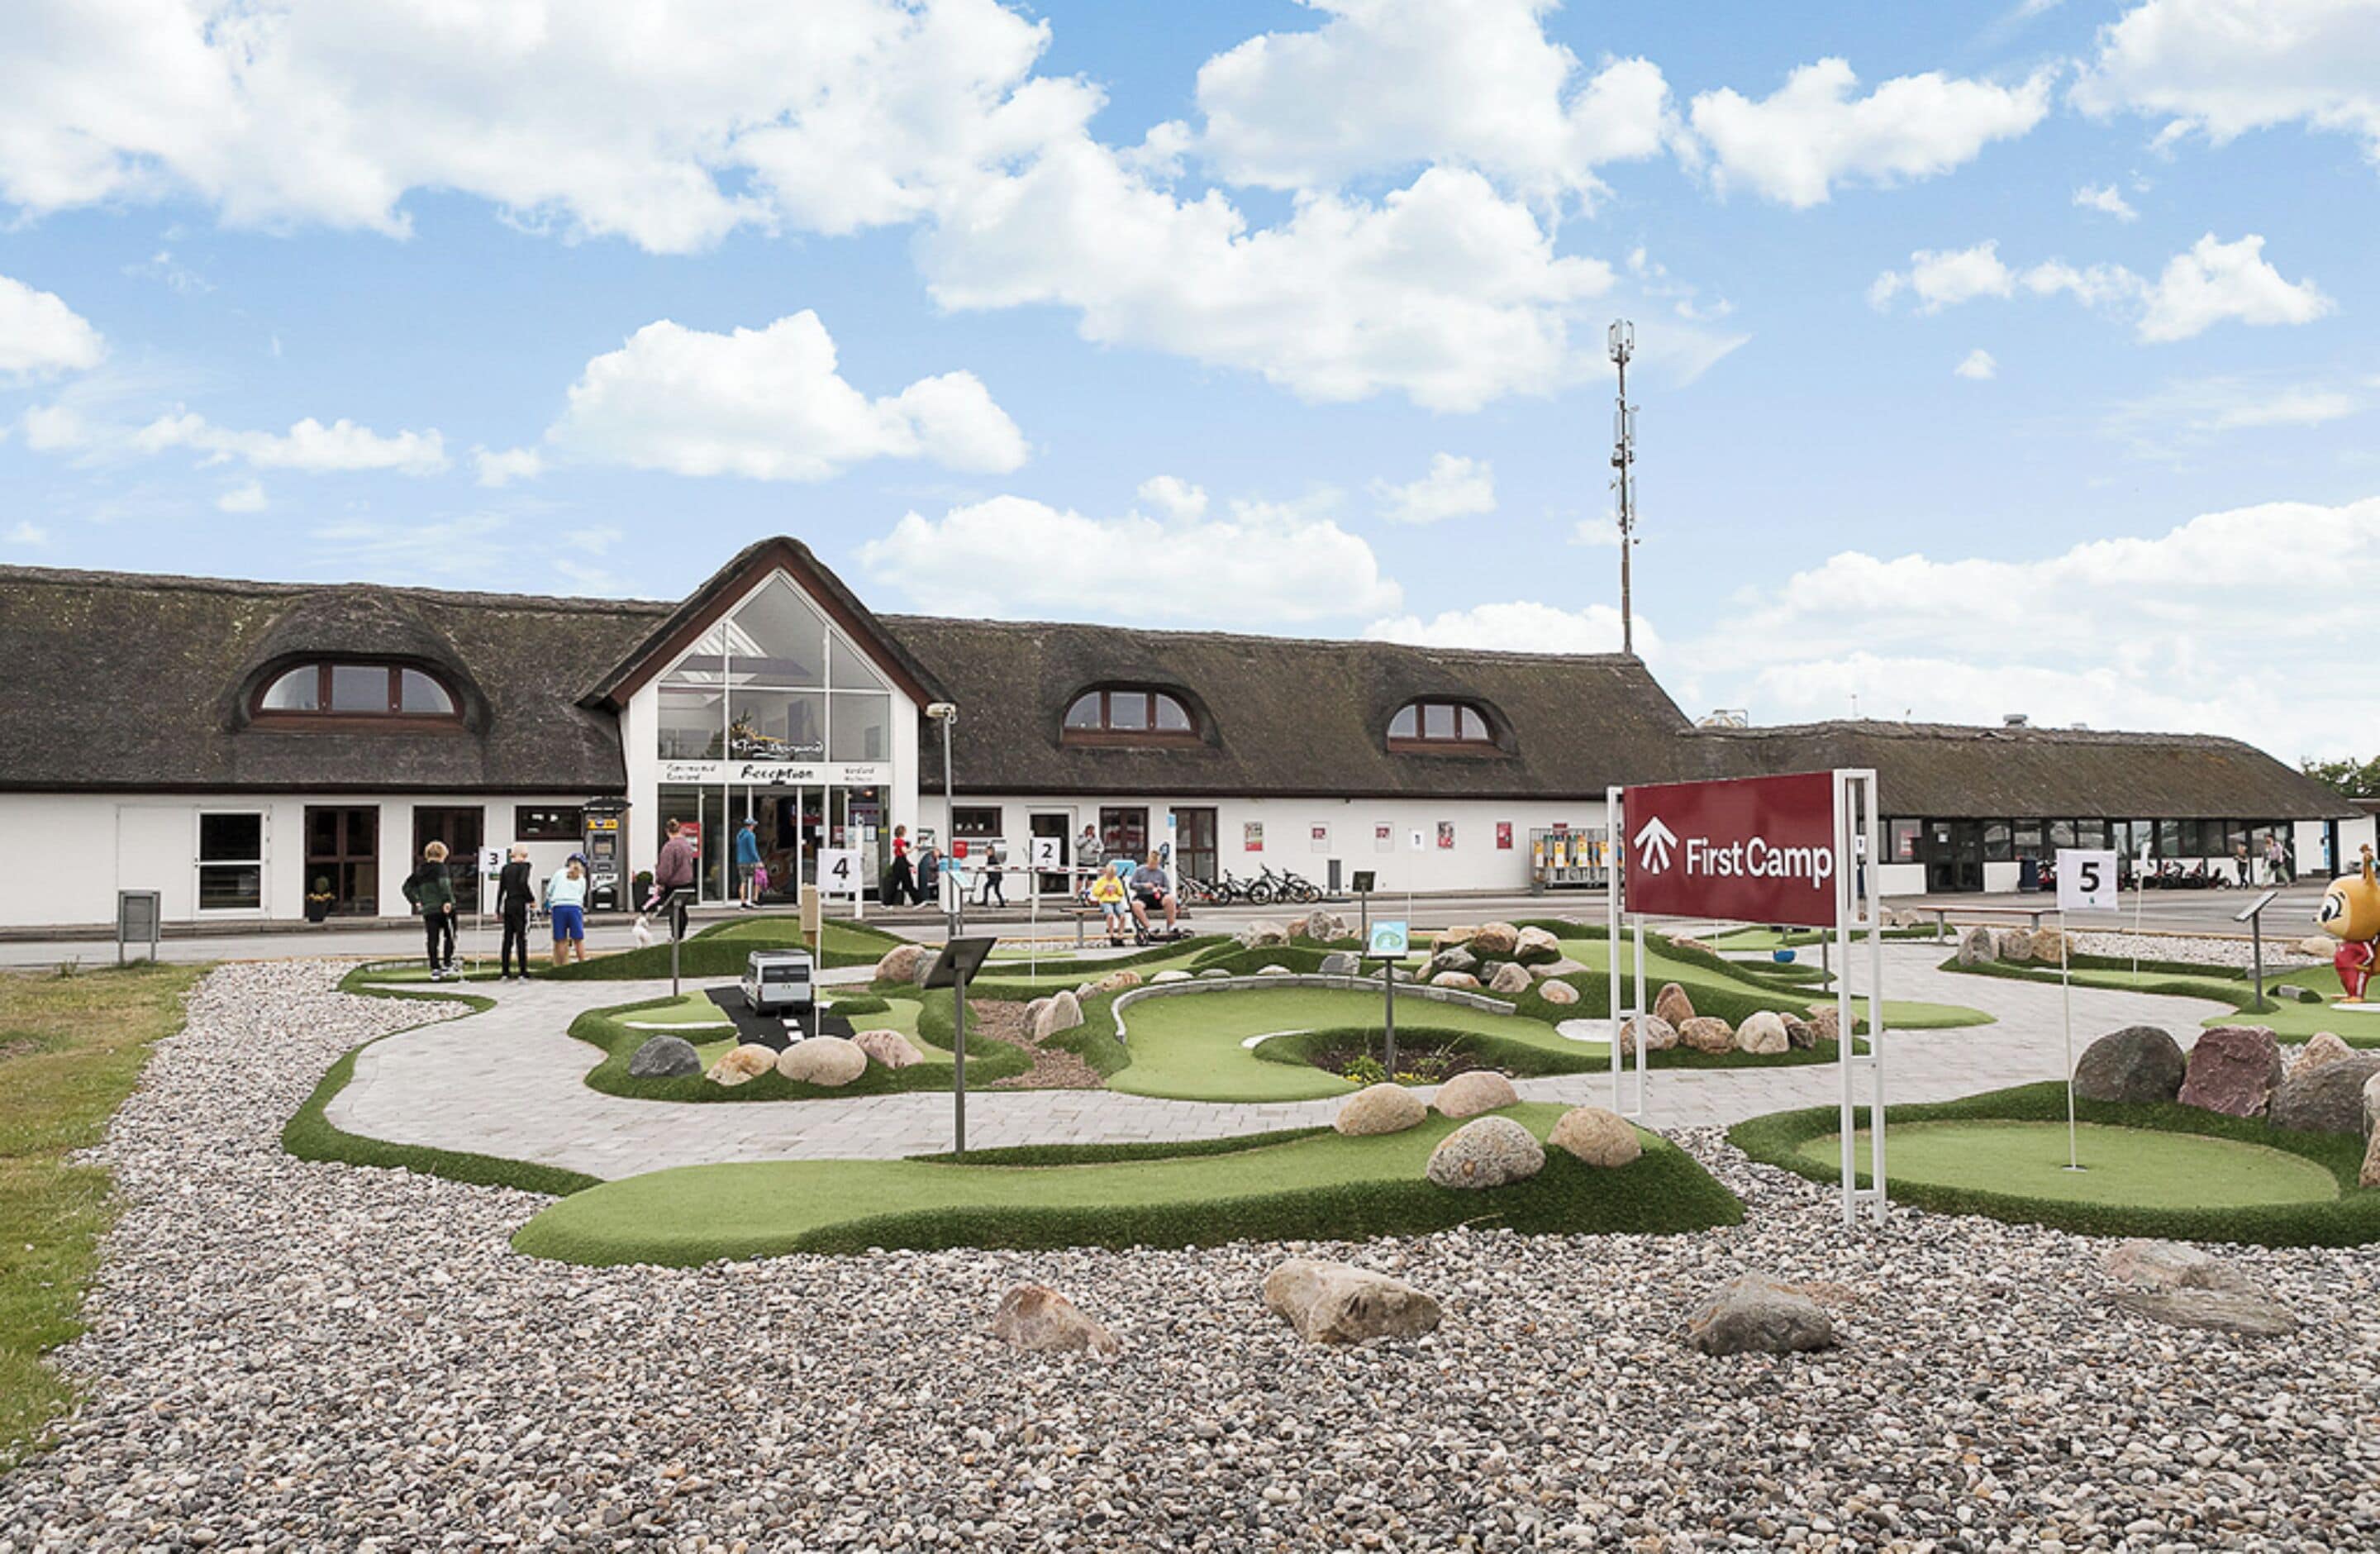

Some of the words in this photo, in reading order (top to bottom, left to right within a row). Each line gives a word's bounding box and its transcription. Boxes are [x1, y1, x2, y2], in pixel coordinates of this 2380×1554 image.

[740, 763, 814, 781] Reception
[489, 852, 498, 865] 3
[1041, 843, 1053, 858] 2
[831, 857, 850, 879] 4
[2080, 861, 2100, 893] 5
